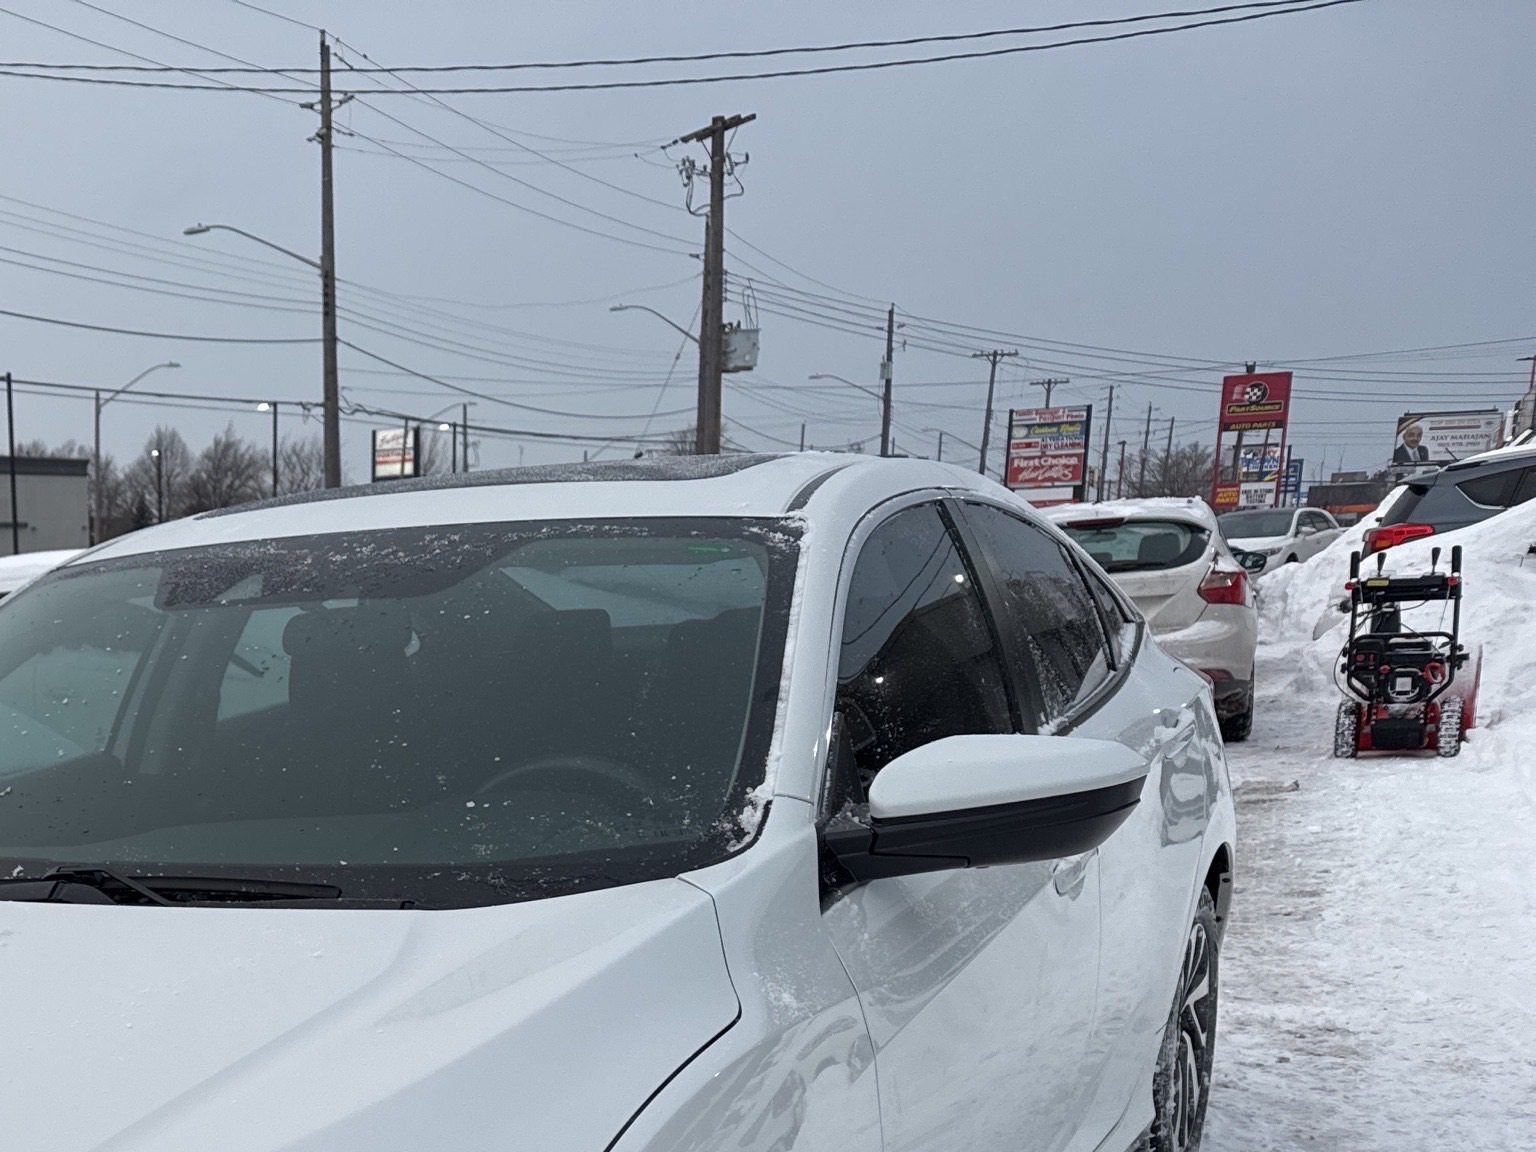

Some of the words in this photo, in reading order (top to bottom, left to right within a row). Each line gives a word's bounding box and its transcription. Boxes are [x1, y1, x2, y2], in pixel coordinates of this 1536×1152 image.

[1252, 421, 1276, 429] PARTS
[1450, 433, 1490, 441] MAHAJAN
[1013, 458, 1040, 468] First
[1040, 456, 1078, 465] Choice
